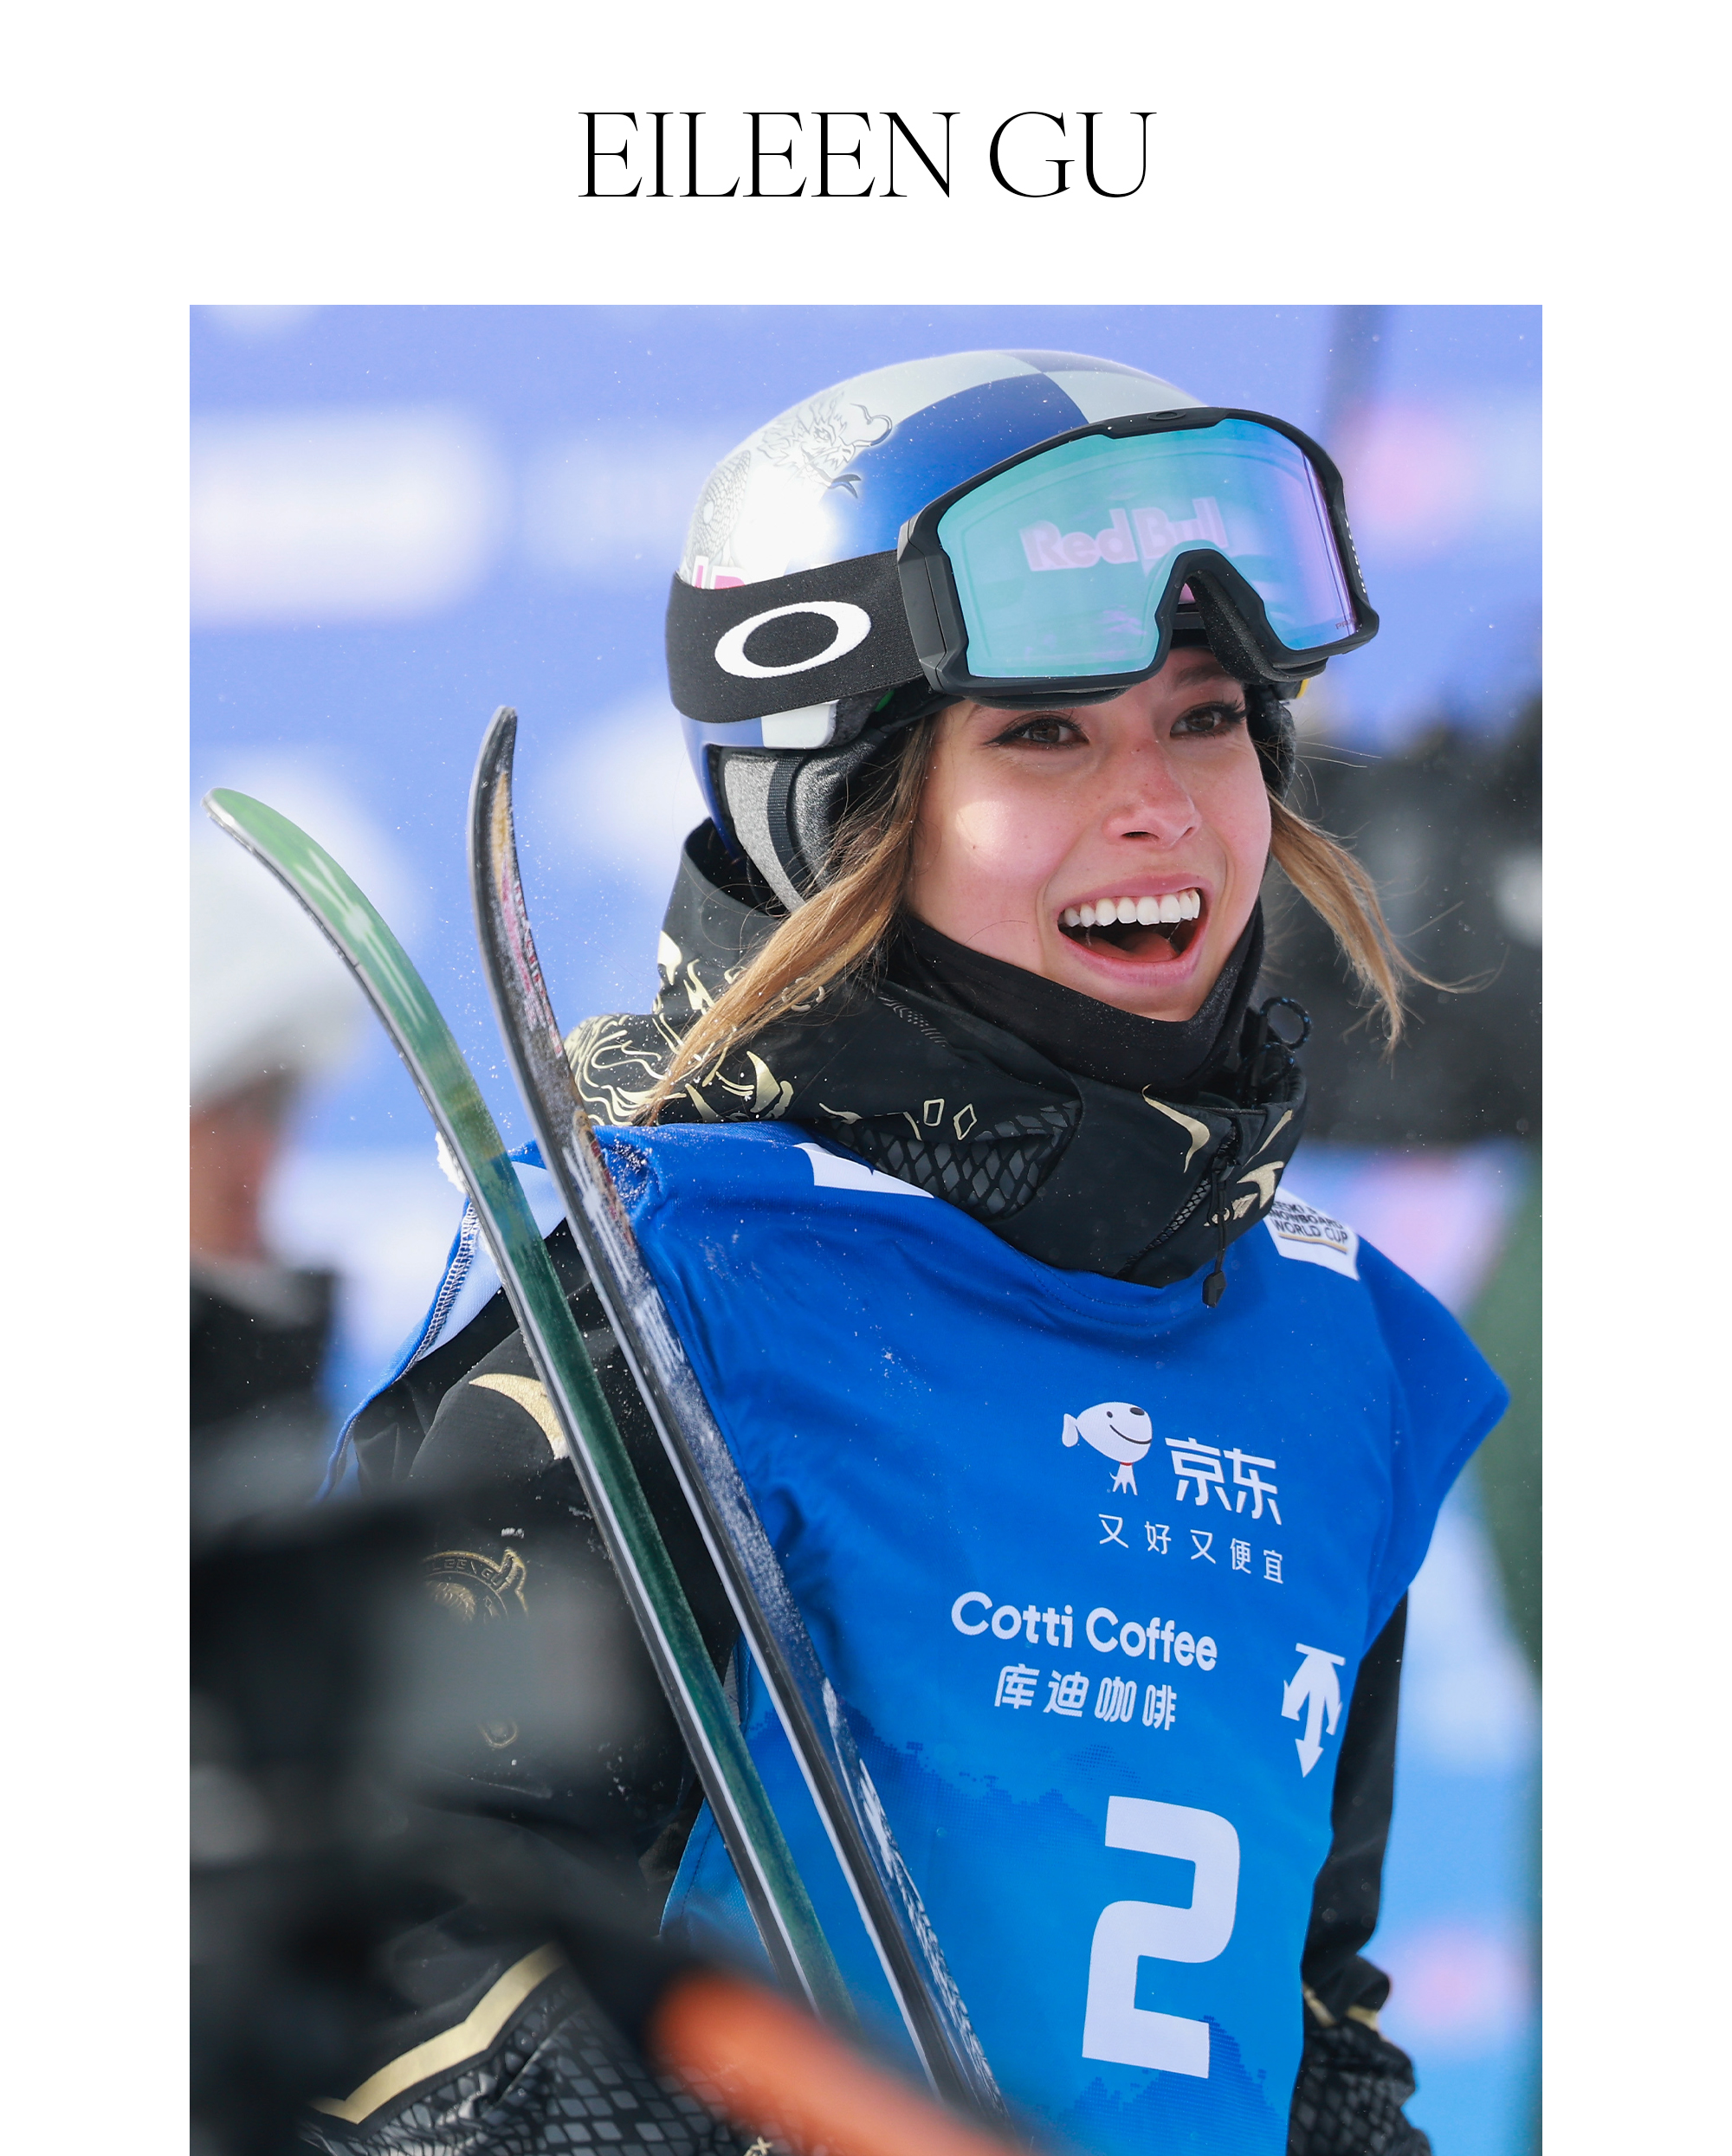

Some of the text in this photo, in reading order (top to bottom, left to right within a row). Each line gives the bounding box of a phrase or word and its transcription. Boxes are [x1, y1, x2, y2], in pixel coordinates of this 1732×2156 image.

[1019, 507, 1139, 571] Red
[1268, 1209, 1344, 1230] NOWBOARD
[1270, 1217, 1347, 1243] WORLD CUP
[1165, 1437, 1282, 1526] 京东
[1098, 1514, 1283, 1584] 又好又便宜
[951, 1591, 1218, 1671] Cotti Coffee
[994, 1663, 1178, 1731] 库迪咖啡
[1082, 1795, 1241, 2079] 2
